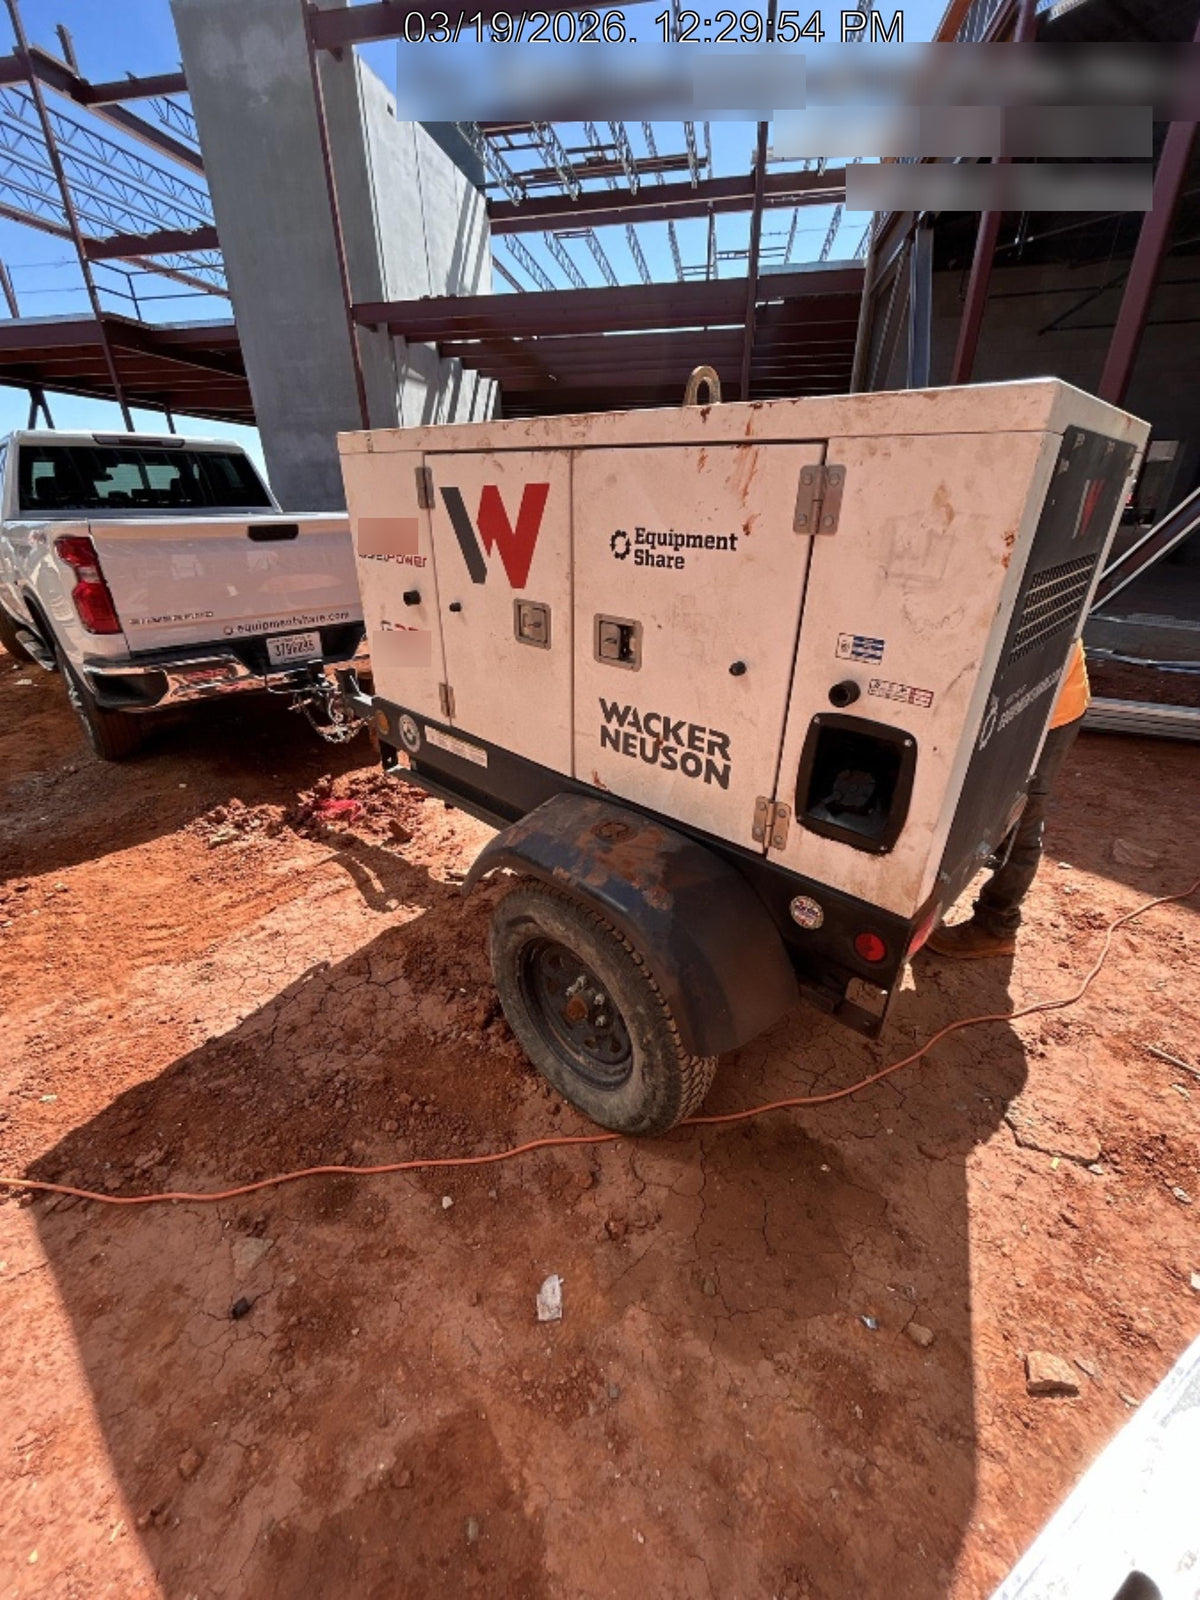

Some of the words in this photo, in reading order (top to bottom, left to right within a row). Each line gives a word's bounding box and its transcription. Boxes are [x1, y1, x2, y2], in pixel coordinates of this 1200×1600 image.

[634, 526, 738, 551] Equipment
[634, 548, 685, 570] Share
[237, 611, 350, 633] equipmentshare.com
[598, 696, 732, 762] WACKER
[600, 724, 732, 790] NEUSON
